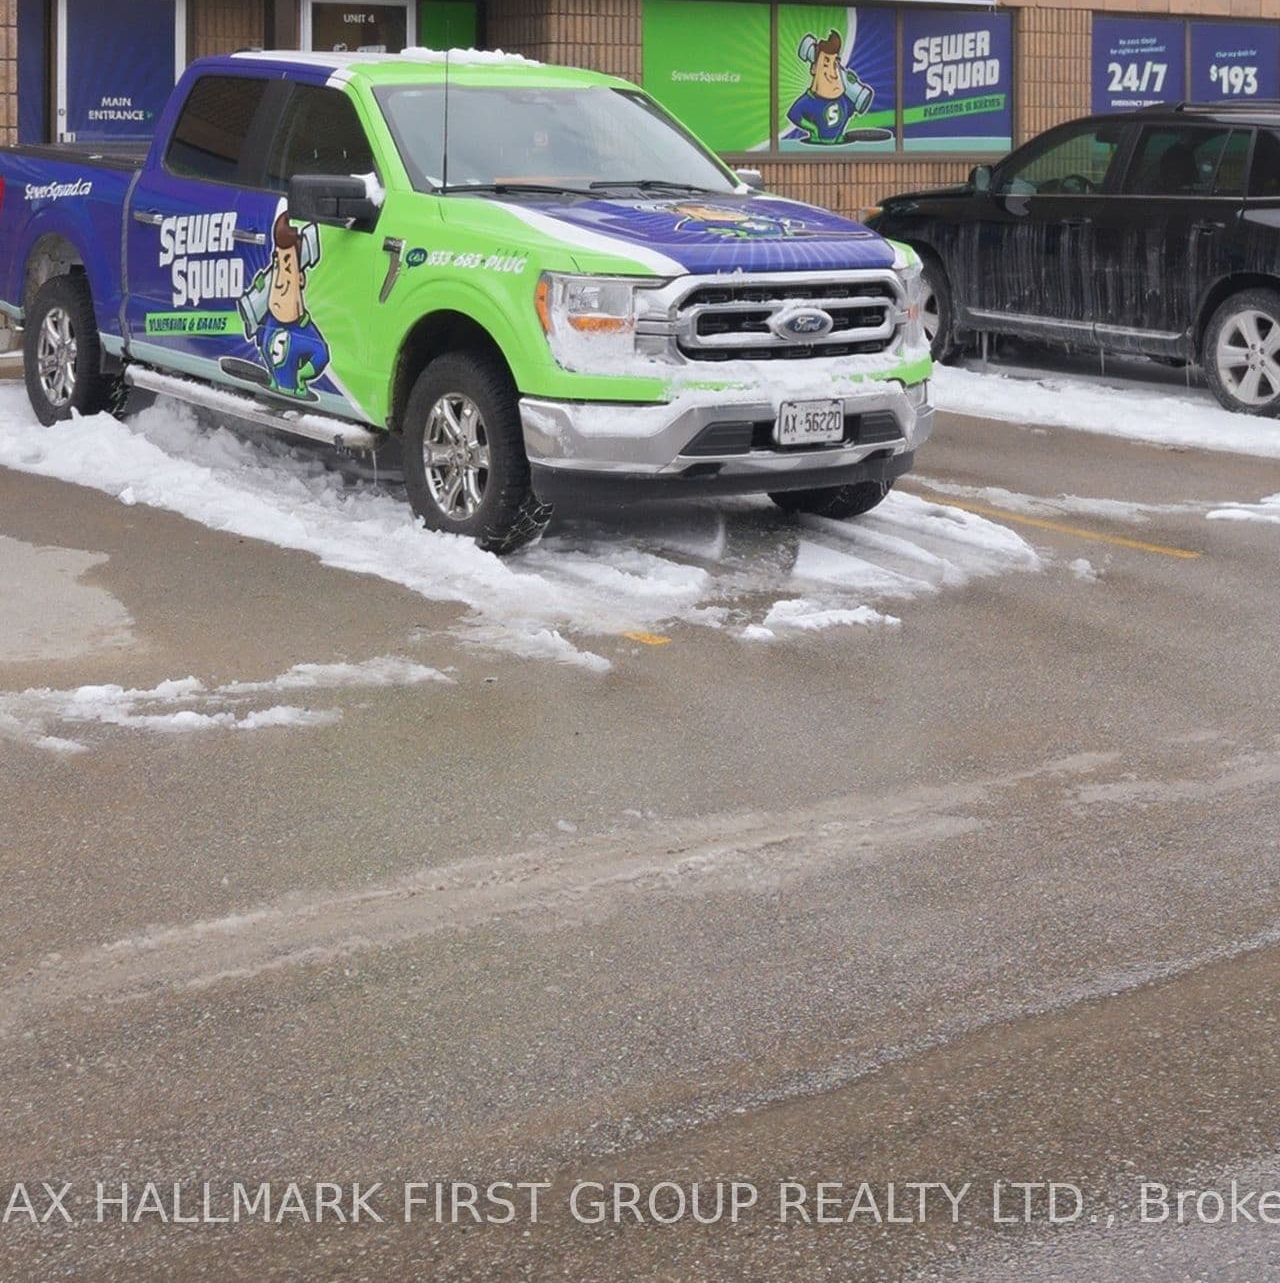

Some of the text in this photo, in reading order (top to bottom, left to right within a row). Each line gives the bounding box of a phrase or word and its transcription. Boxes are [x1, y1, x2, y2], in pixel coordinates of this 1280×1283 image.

[343, 14, 375, 23] UNIT 4
[912, 30, 990, 74] SEWER
[925, 59, 999, 100] SQUAD
[1107, 61, 1168, 92] 24/7
[88, 110, 144, 120] ENTRANCE
[101, 97, 131, 107] MAIN
[24, 178, 93, 201] SewerSquad.ca
[159, 212, 238, 267] SEWER
[172, 256, 245, 308] SQUAD
[783, 411, 841, 434] AX 56220
